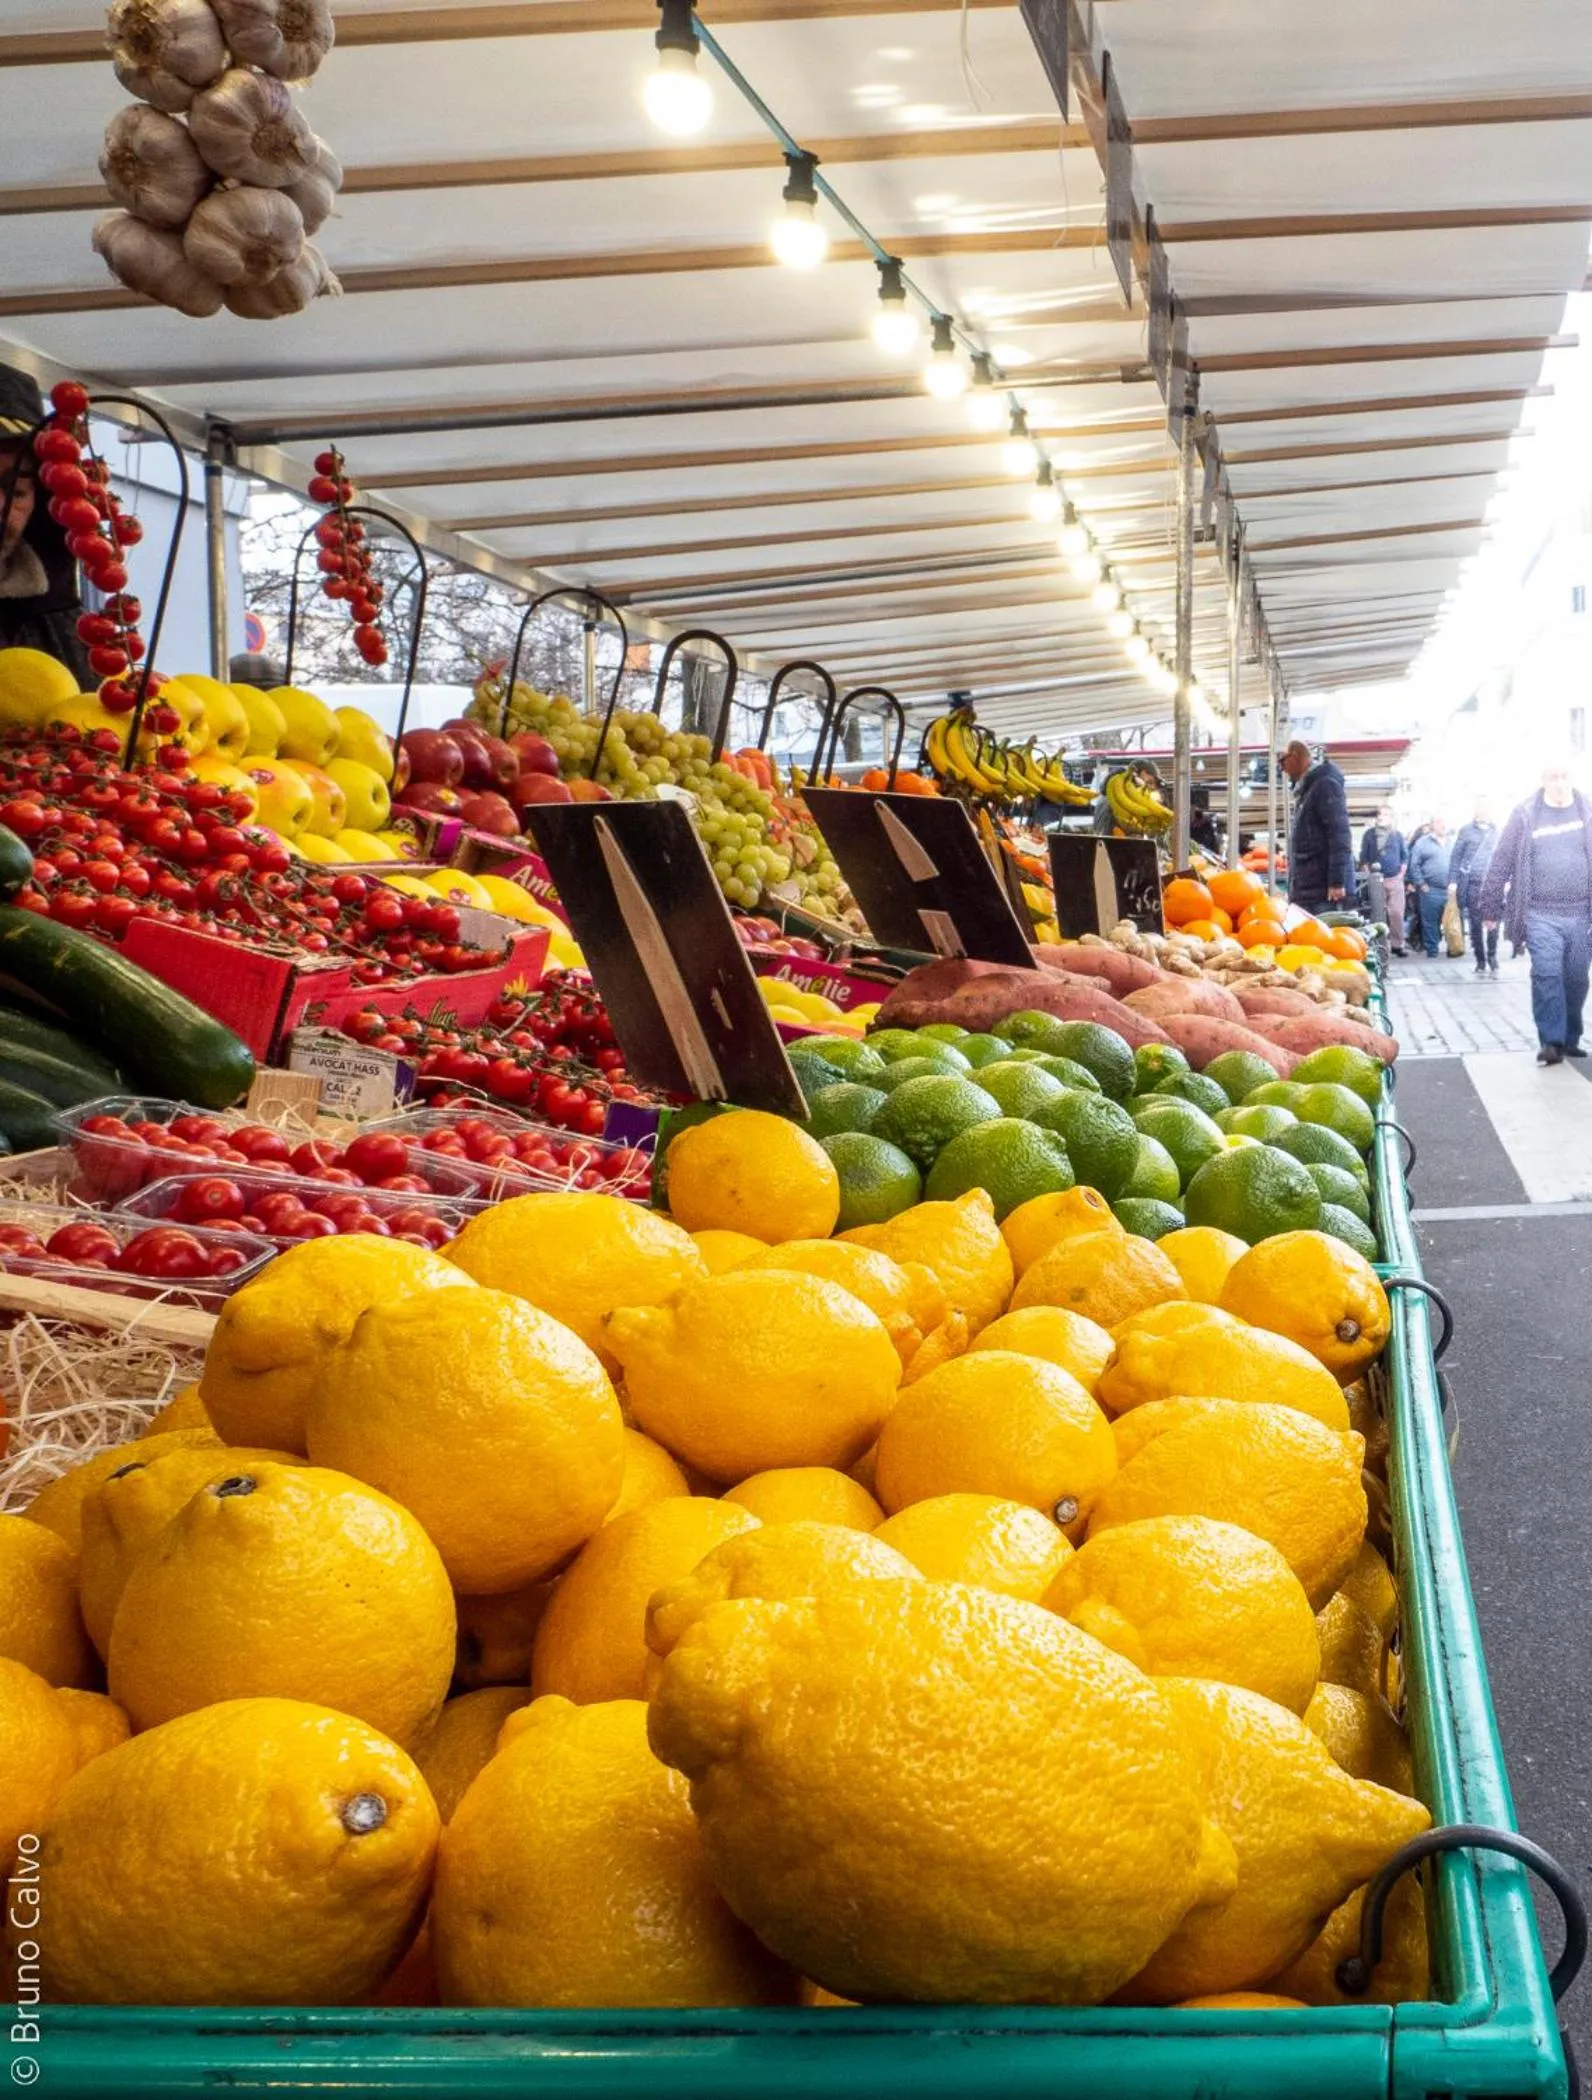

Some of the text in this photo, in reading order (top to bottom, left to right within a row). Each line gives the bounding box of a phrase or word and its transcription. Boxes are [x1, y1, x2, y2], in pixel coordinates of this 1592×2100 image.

[774, 963, 851, 1002] Amélie
[309, 1057, 351, 1071] AVOCAT
[354, 1064, 380, 1076] HASS
